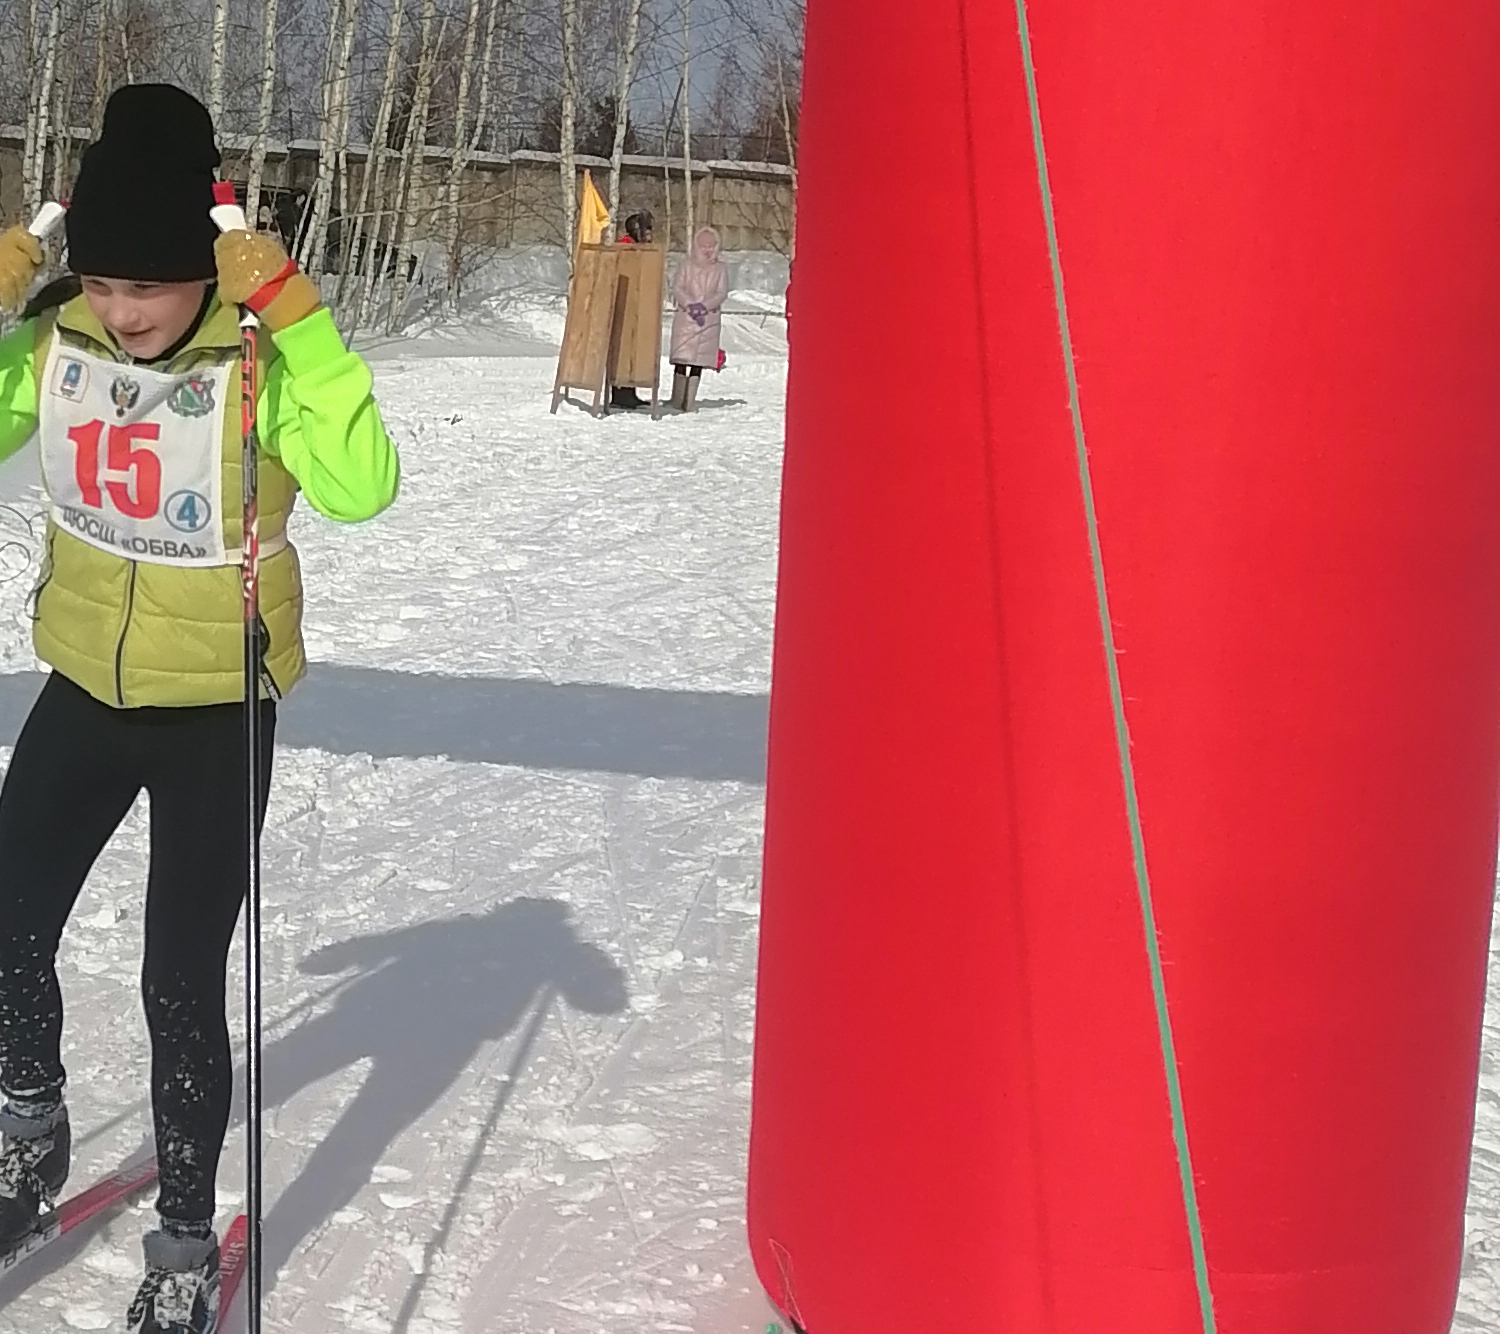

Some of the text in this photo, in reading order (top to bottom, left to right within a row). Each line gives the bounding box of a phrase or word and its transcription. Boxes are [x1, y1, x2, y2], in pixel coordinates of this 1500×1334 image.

[67, 419, 161, 520] 15
[63, 506, 207, 558] ДЮСШ «ОБВА»
[177, 495, 199, 528] 4
